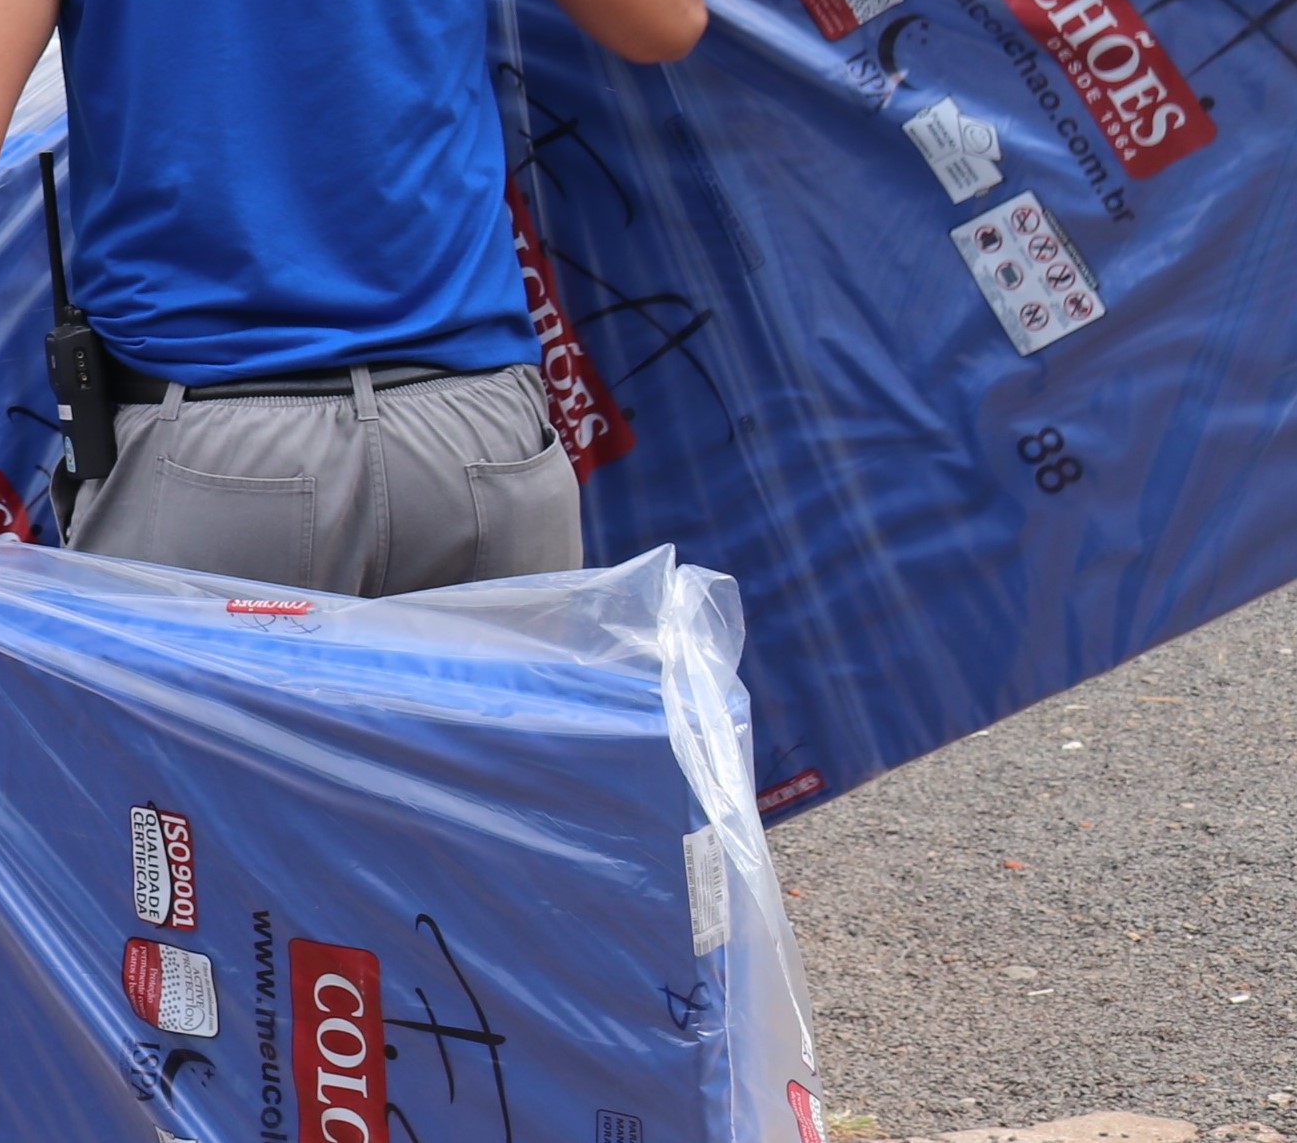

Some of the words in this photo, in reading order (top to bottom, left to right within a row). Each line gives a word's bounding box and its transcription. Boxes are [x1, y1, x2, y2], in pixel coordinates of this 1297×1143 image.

[1046, 37, 1099, 107] DESDE
[1101, 109, 1136, 162] 1964
[133, 811, 147, 915] CERTIFICADA
[144, 813, 160, 918] QUALIDADE
[138, 946, 147, 995] permanente
[147, 968, 158, 1004] Proteção
[182, 952, 196, 1027] PROTECTION
[193, 968, 204, 1008] ACTIVE
